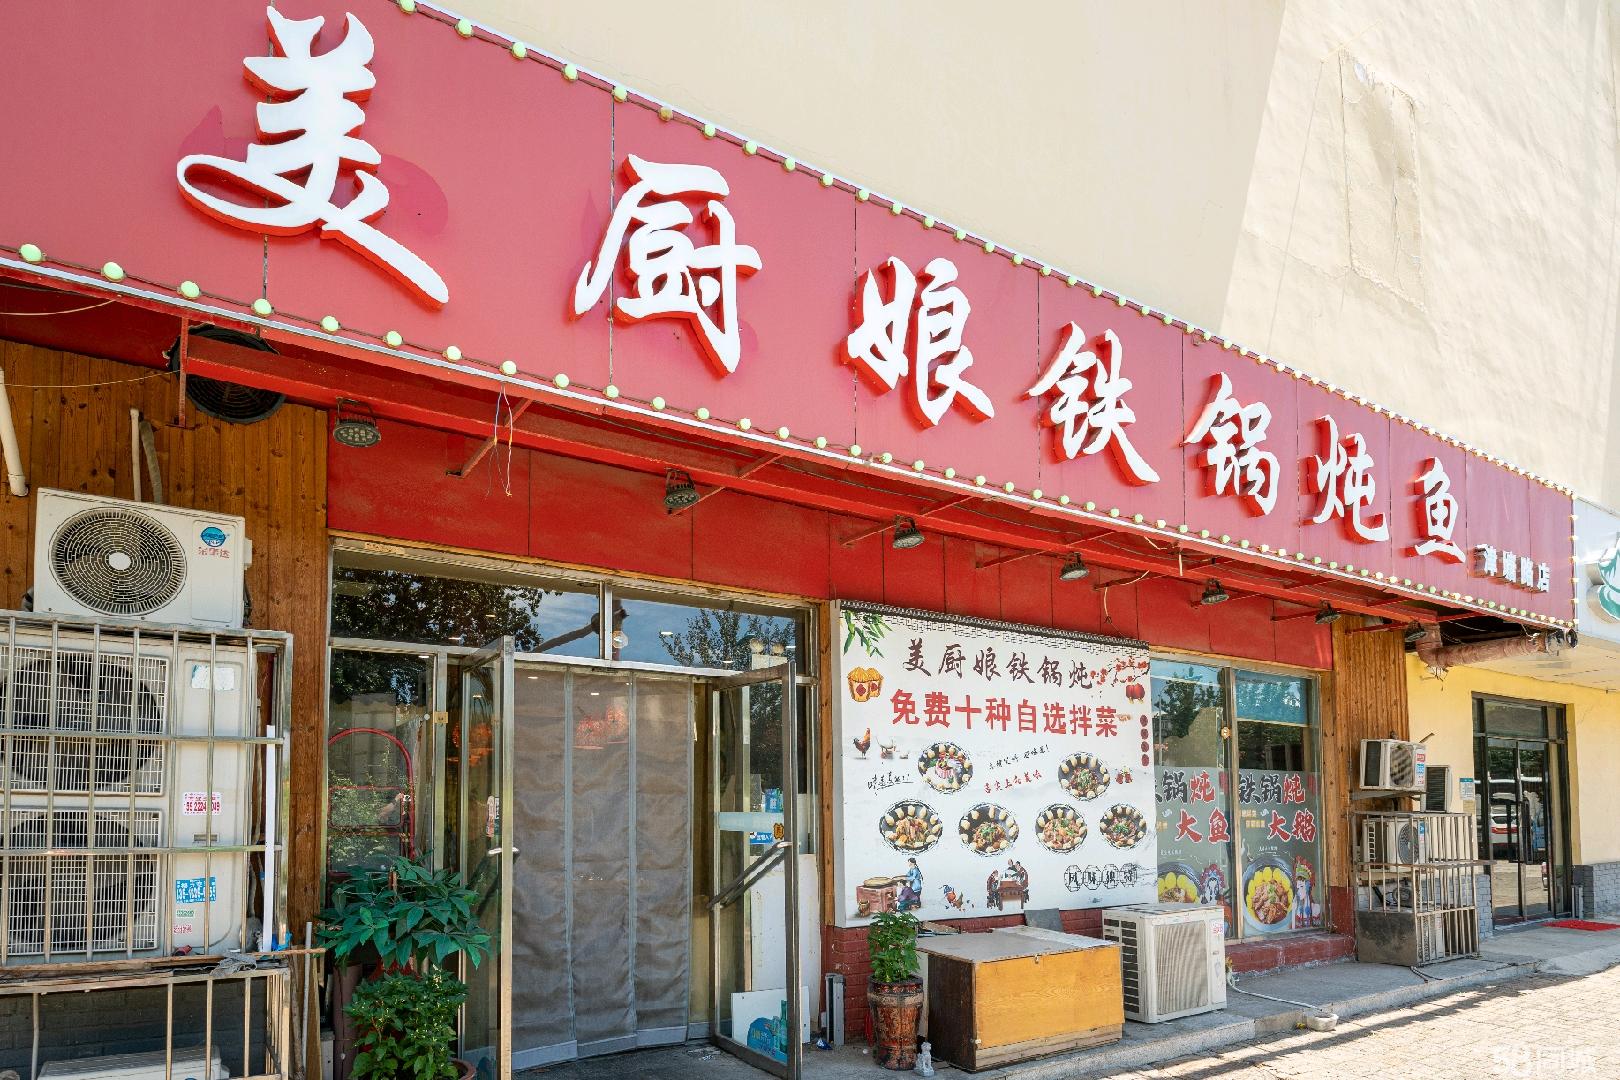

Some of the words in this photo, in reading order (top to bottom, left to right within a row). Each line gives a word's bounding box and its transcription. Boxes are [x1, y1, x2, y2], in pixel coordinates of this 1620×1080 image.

[177, 6, 1467, 563] 美厨娘铁锅炖鱼
[902, 638, 1093, 690] 美厨娘铁锅炖
[889, 689, 1118, 738] 免费十种自选拌菜
[1154, 769, 1217, 806] 锅炖
[1175, 807, 1231, 843] 大鱼
[1267, 808, 1317, 843] 大鹅
